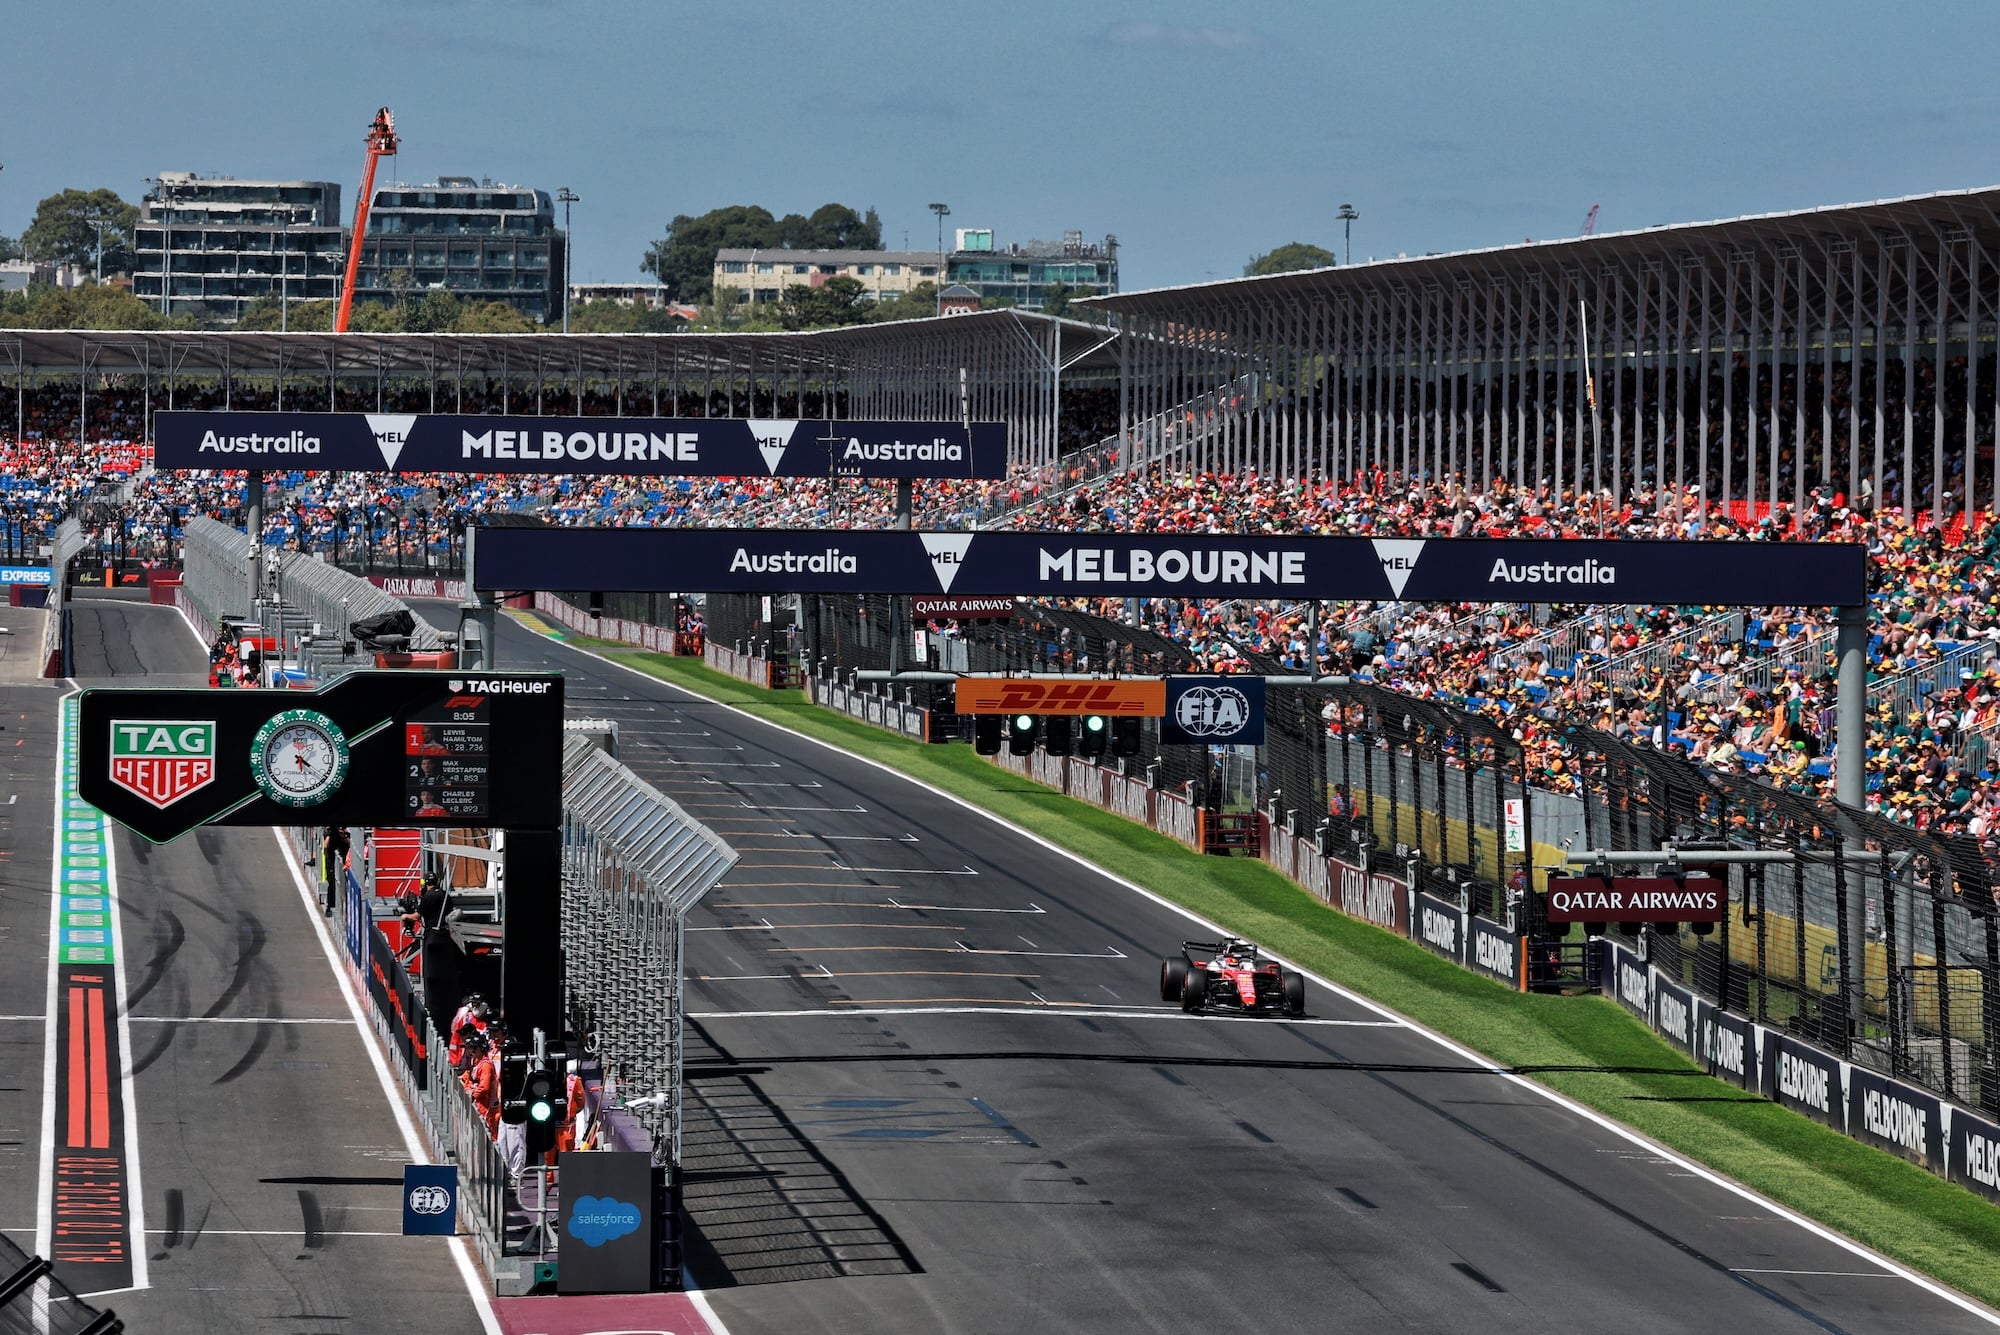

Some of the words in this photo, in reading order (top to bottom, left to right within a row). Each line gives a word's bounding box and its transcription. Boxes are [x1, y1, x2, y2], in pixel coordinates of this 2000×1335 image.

[199, 430, 320, 453] Australia
[374, 432, 406, 443] MEL
[462, 429, 699, 461] MELBOURNE
[756, 437, 787, 448] MEL
[844, 437, 962, 461] Australia
[729, 548, 857, 573] Australia
[929, 551, 962, 564] MEL
[1039, 547, 1305, 584] MELBOURNE
[1381, 557, 1414, 570] MEL
[1, 570, 51, 581] EXPRESS
[1488, 558, 1616, 584] Australia
[916, 600, 958, 614] QATAR
[961, 599, 1013, 611] AIRWAYS
[999, 684, 1122, 710] DHL
[271, 714, 285, 726] 55
[317, 714, 330, 726] 05
[453, 712, 475, 721] 8:05
[119, 727, 206, 753] TAG
[256, 730, 267, 742] 50
[410, 734, 419, 746] 1
[251, 752, 259, 765] 45
[342, 755, 349, 764] 15
[409, 765, 419, 777] 2
[117, 761, 208, 801] HEUER
[254, 774, 265, 787] 40
[409, 796, 418, 807] 3
[1341, 866, 1365, 916] QATAR
[1552, 892, 1623, 912] QATAR
[1628, 892, 1718, 910] AIRWAYS
[1422, 905, 1456, 953] MELBOURNE
[1475, 929, 1514, 978] MELBOURNE
[1775, 1050, 1829, 1113] MELBOURNE
[1864, 1087, 1927, 1155] MELBOURNE
[58, 1157, 120, 1175] FOR
[57, 1181, 122, 1216] DRIVE
[578, 1212, 634, 1227] salesforce
[56, 1222, 122, 1235] TO
[55, 1241, 124, 1263] ALL
